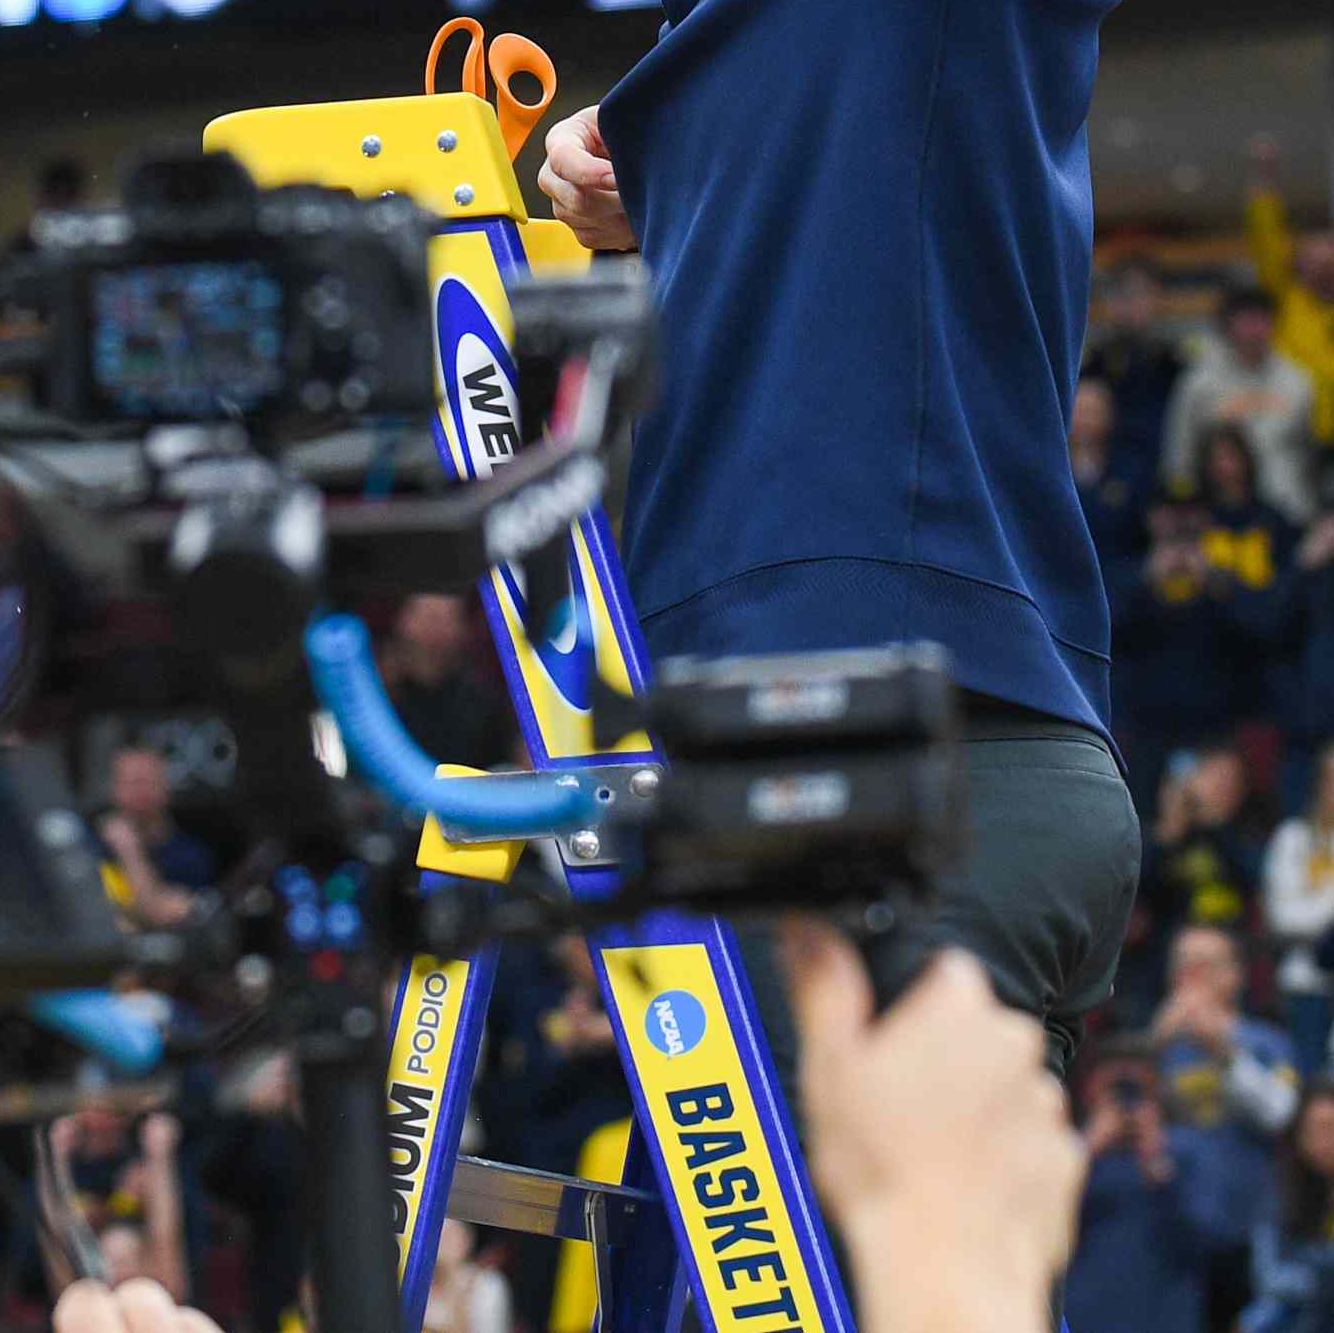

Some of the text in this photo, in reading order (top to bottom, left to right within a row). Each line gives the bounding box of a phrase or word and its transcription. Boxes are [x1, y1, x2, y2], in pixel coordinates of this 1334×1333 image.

[407, 972, 448, 1075] PODIO
[653, 1000, 685, 1056] NCAA
[665, 1082, 805, 1333] BASKET
